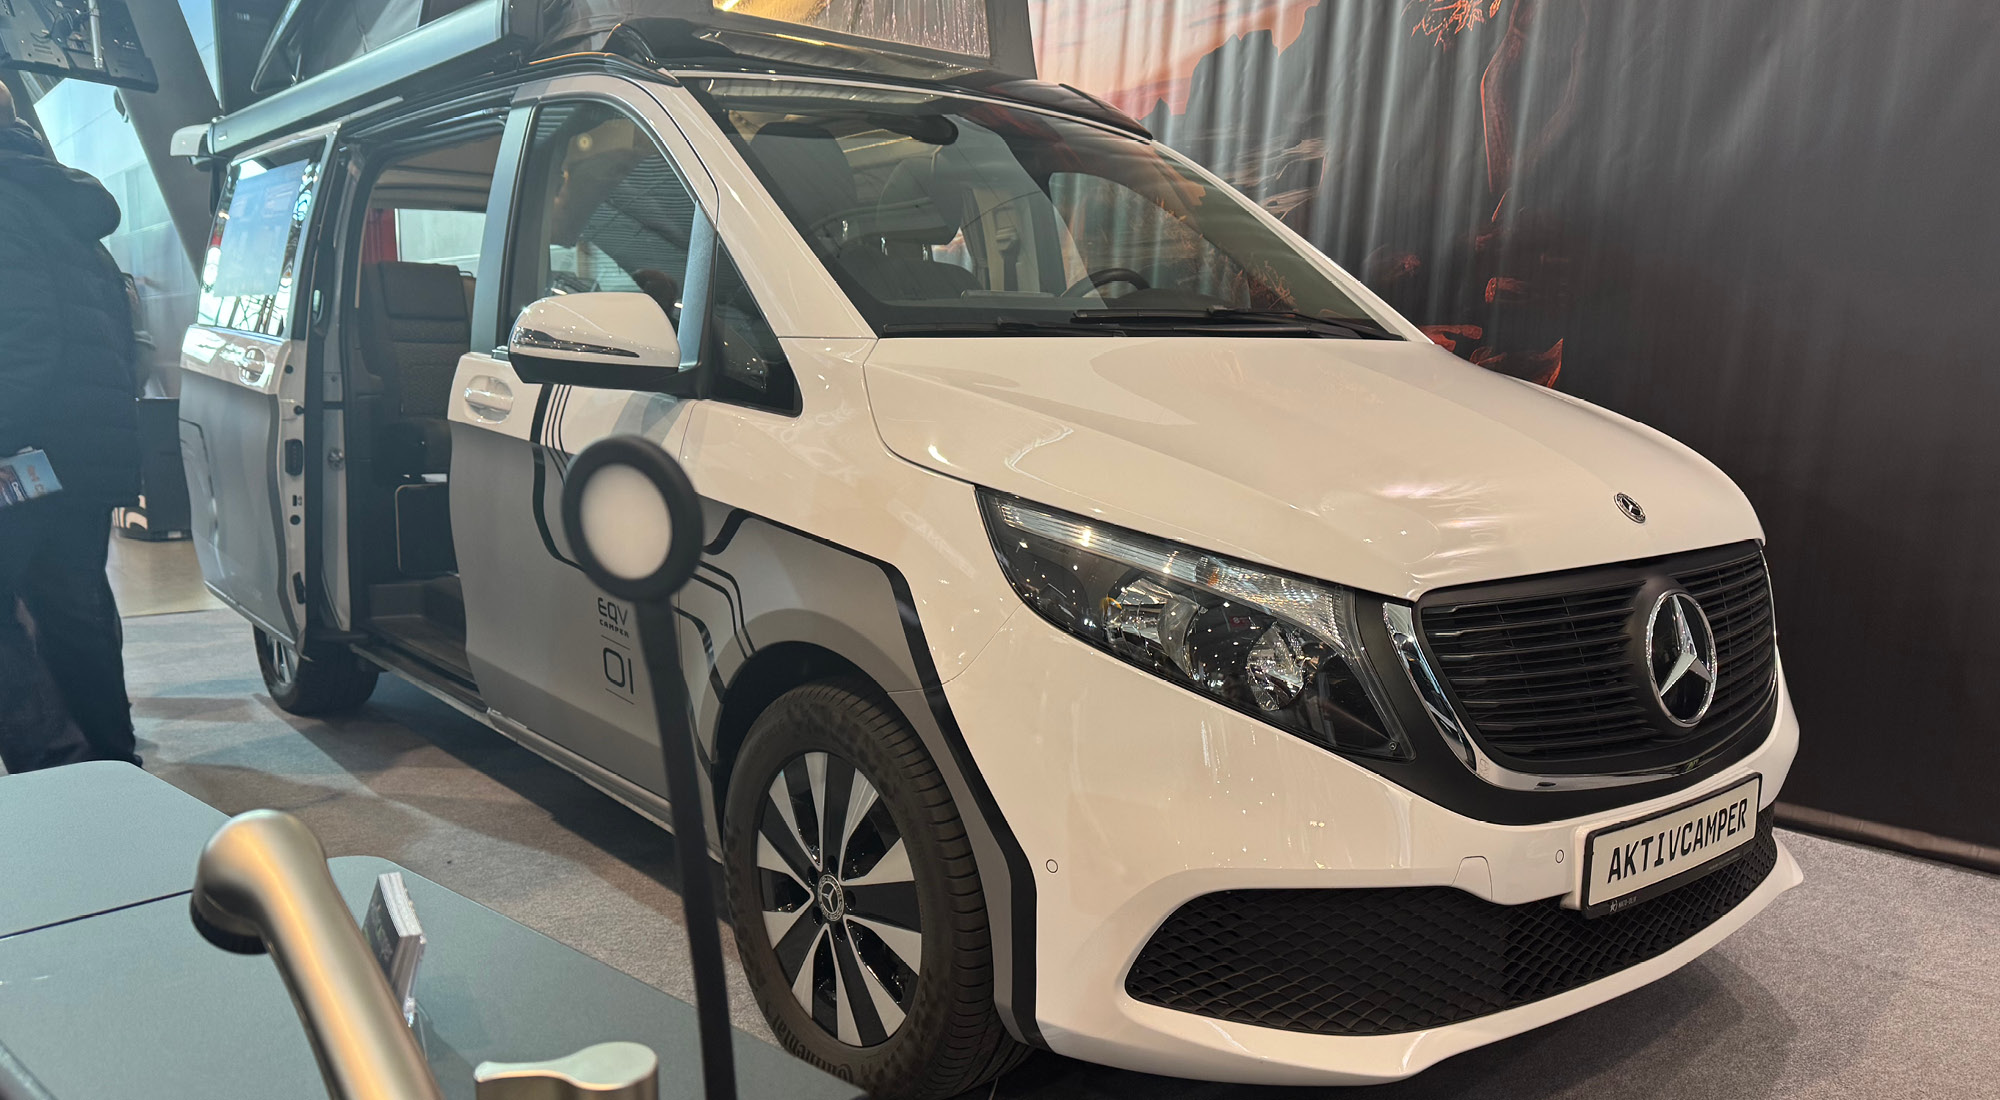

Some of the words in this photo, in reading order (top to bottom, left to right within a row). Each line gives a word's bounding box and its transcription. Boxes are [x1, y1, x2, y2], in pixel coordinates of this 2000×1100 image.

[598, 597, 628, 625] EQV
[600, 618, 630, 639] CAMPER
[603, 647, 635, 695] 01
[1607, 798, 1748, 884] AKTIVCAMPER
